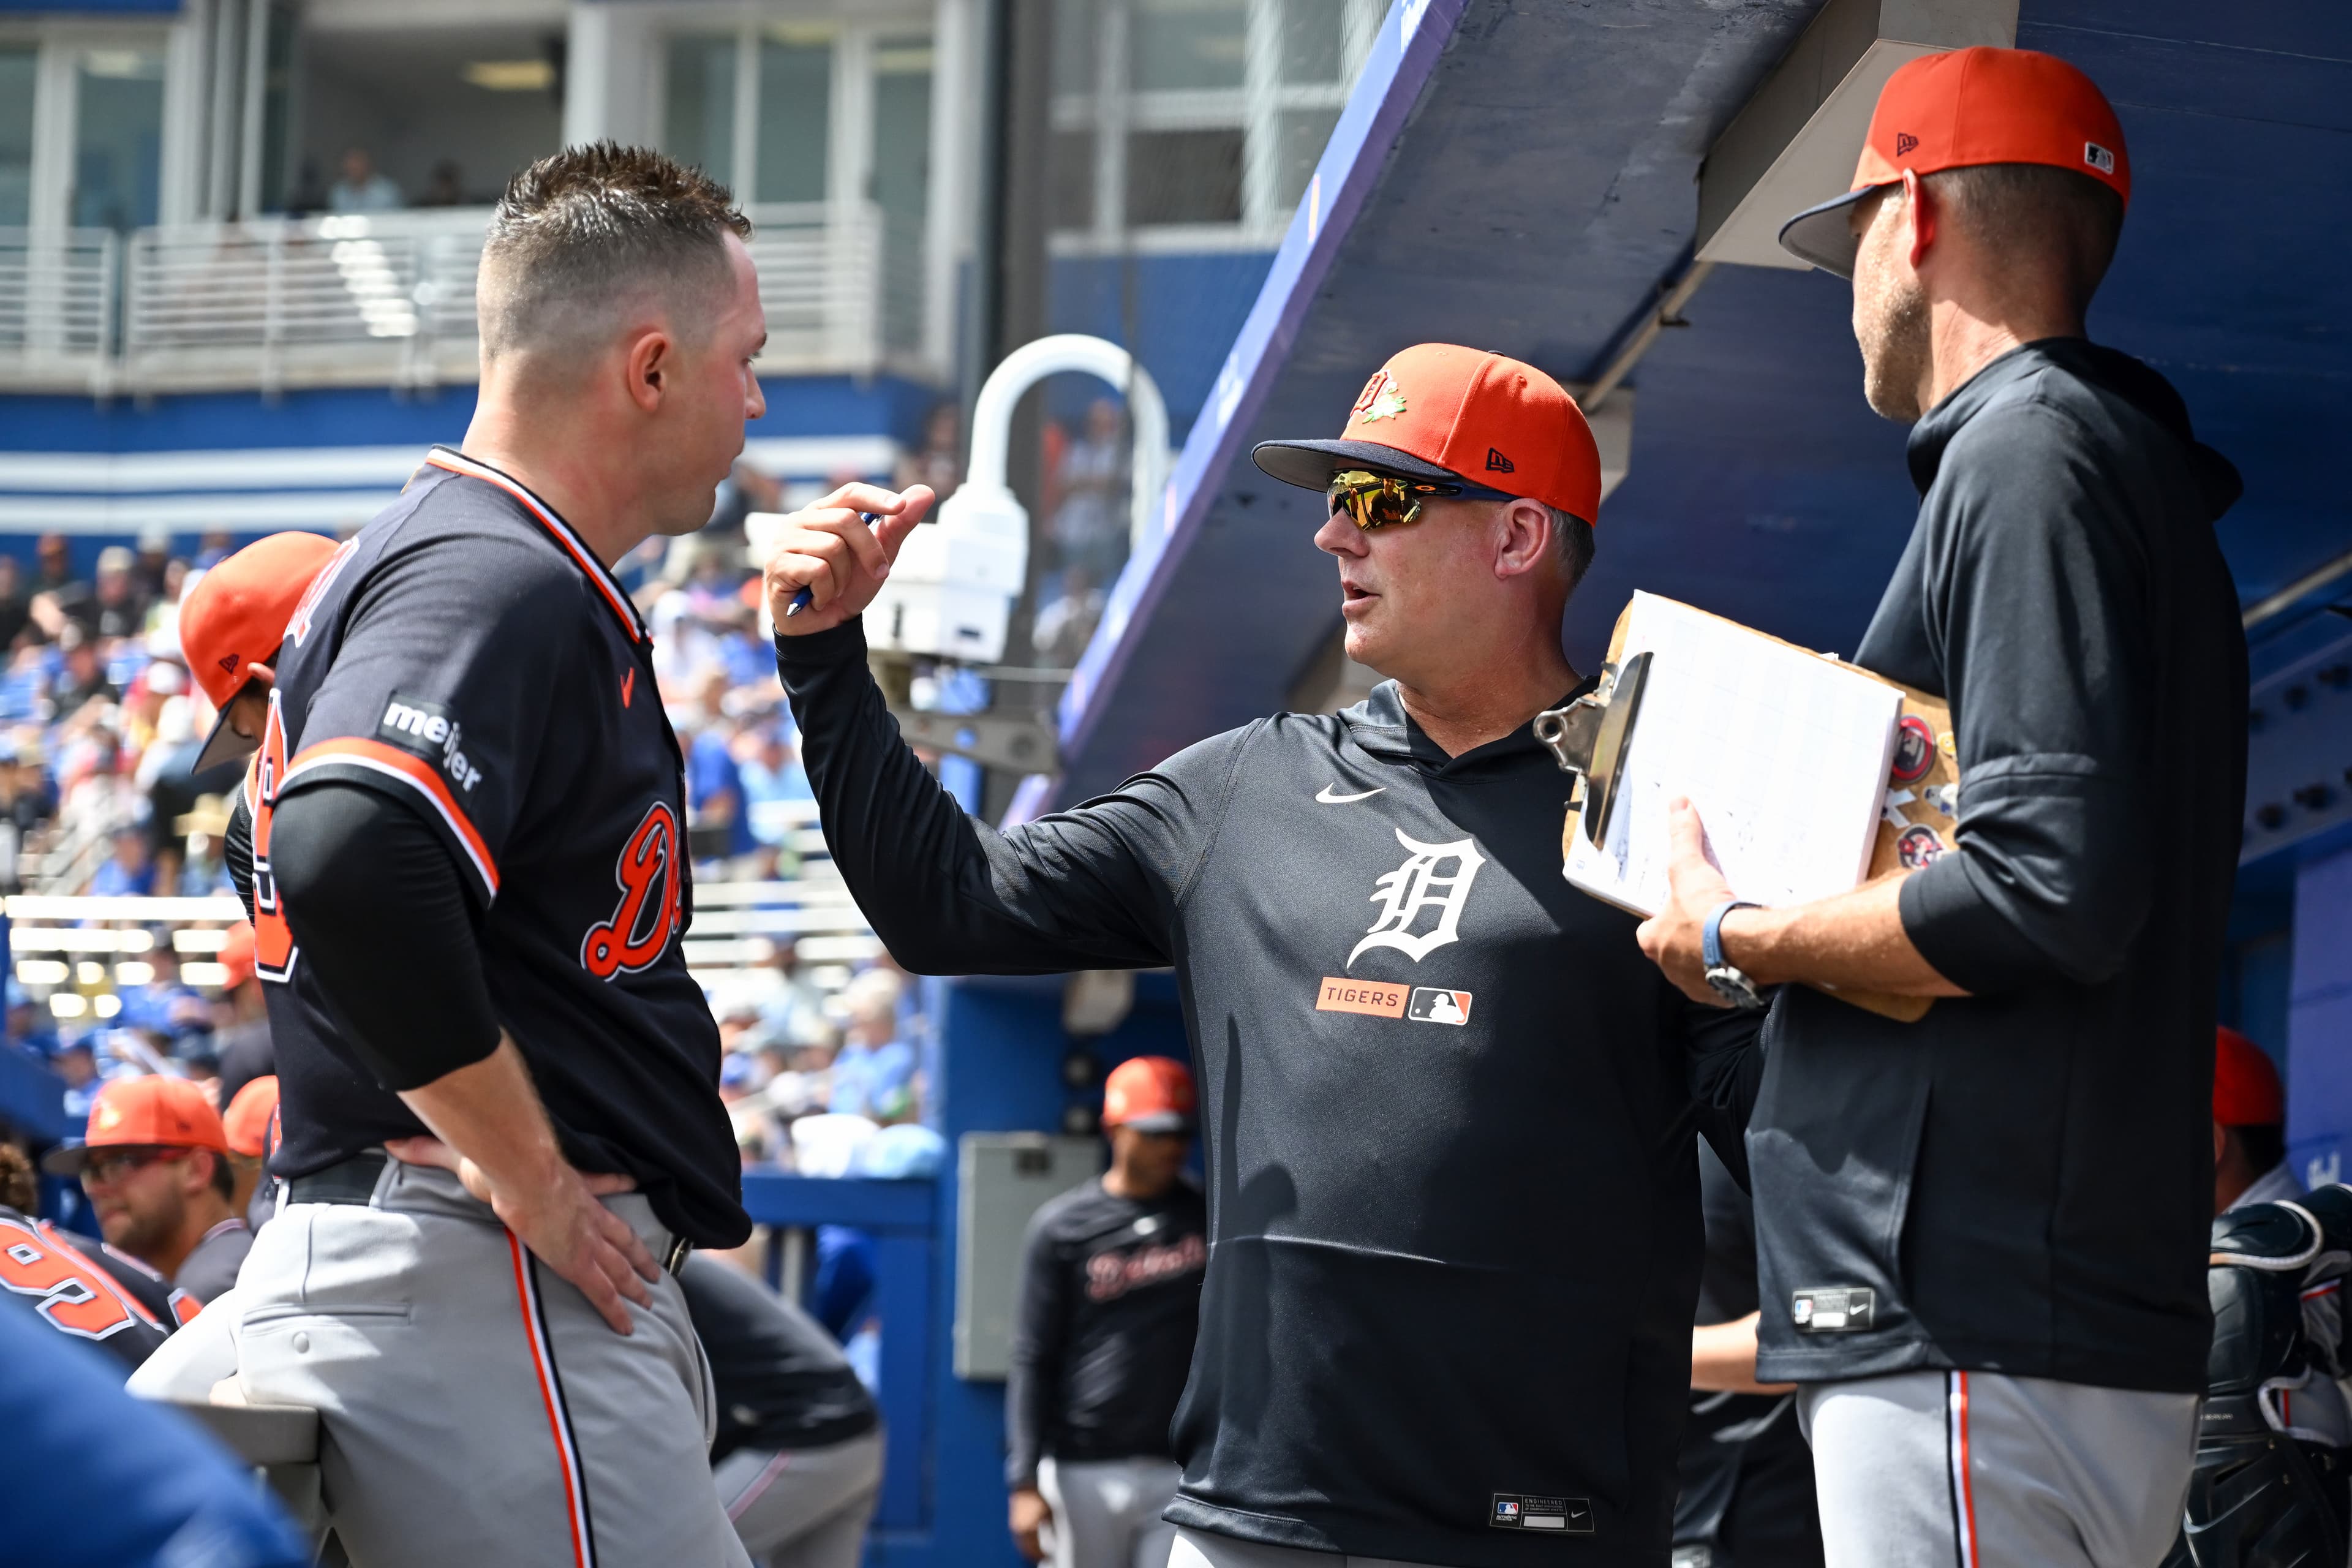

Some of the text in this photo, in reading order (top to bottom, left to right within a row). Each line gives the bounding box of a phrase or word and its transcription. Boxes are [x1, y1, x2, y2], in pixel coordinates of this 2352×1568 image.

[383, 702, 483, 792] meijer
[1347, 827, 1486, 969] D
[1327, 986, 1399, 1007] TIGERS
